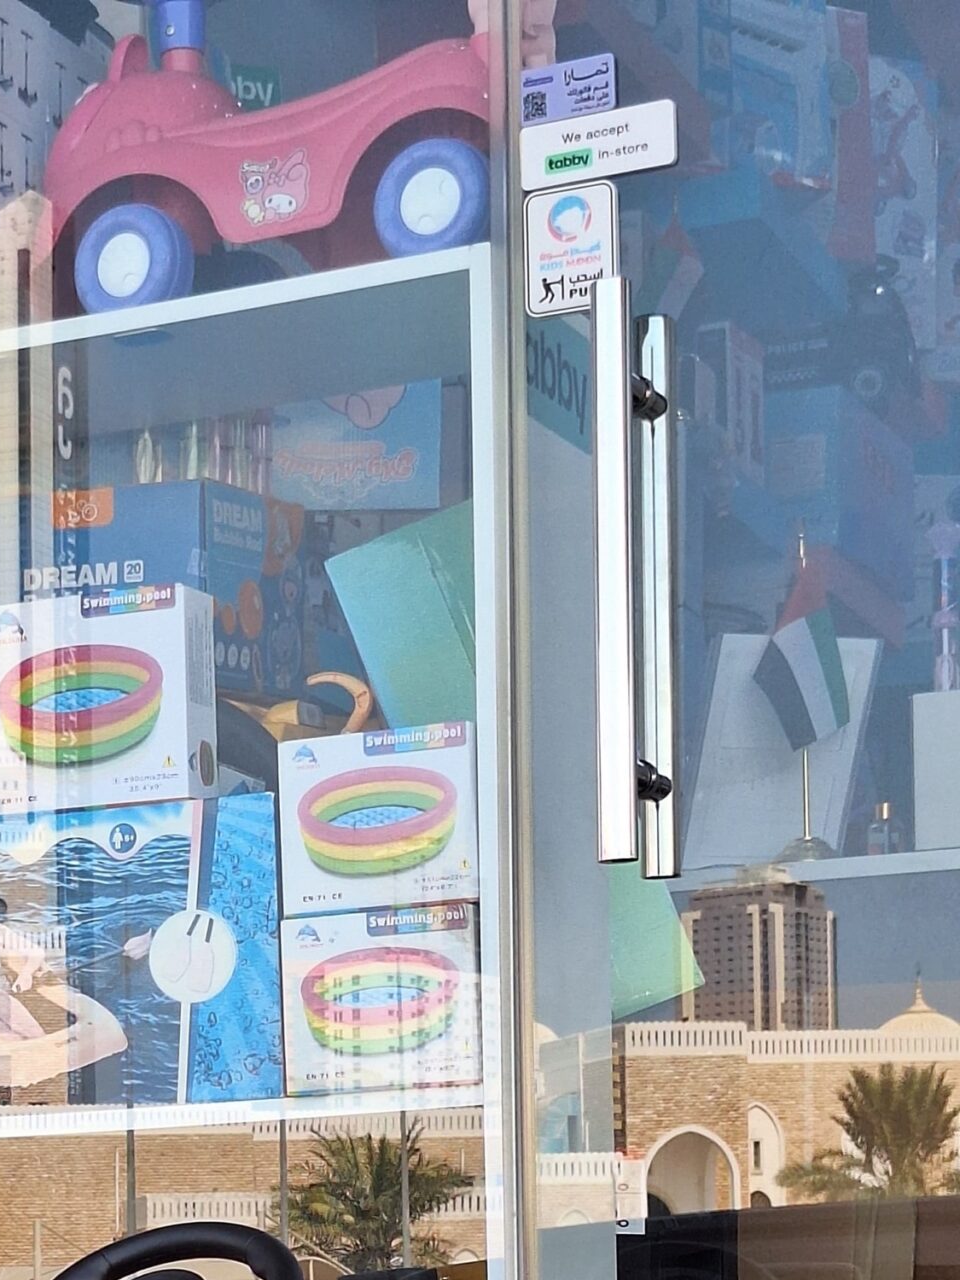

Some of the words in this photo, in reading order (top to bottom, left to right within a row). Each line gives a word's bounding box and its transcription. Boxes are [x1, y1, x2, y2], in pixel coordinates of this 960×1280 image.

[563, 61, 610, 87] تمارا
[561, 132, 582, 145] We
[585, 123, 630, 141] accept
[548, 154, 590, 171] tabby
[597, 142, 649, 160] in-store
[568, 268, 604, 287] اسحب
[568, 286, 589, 300] PU
[526, 331, 587, 436] abby
[22, 561, 118, 592] DREAM
[126, 562, 142, 576] 20
